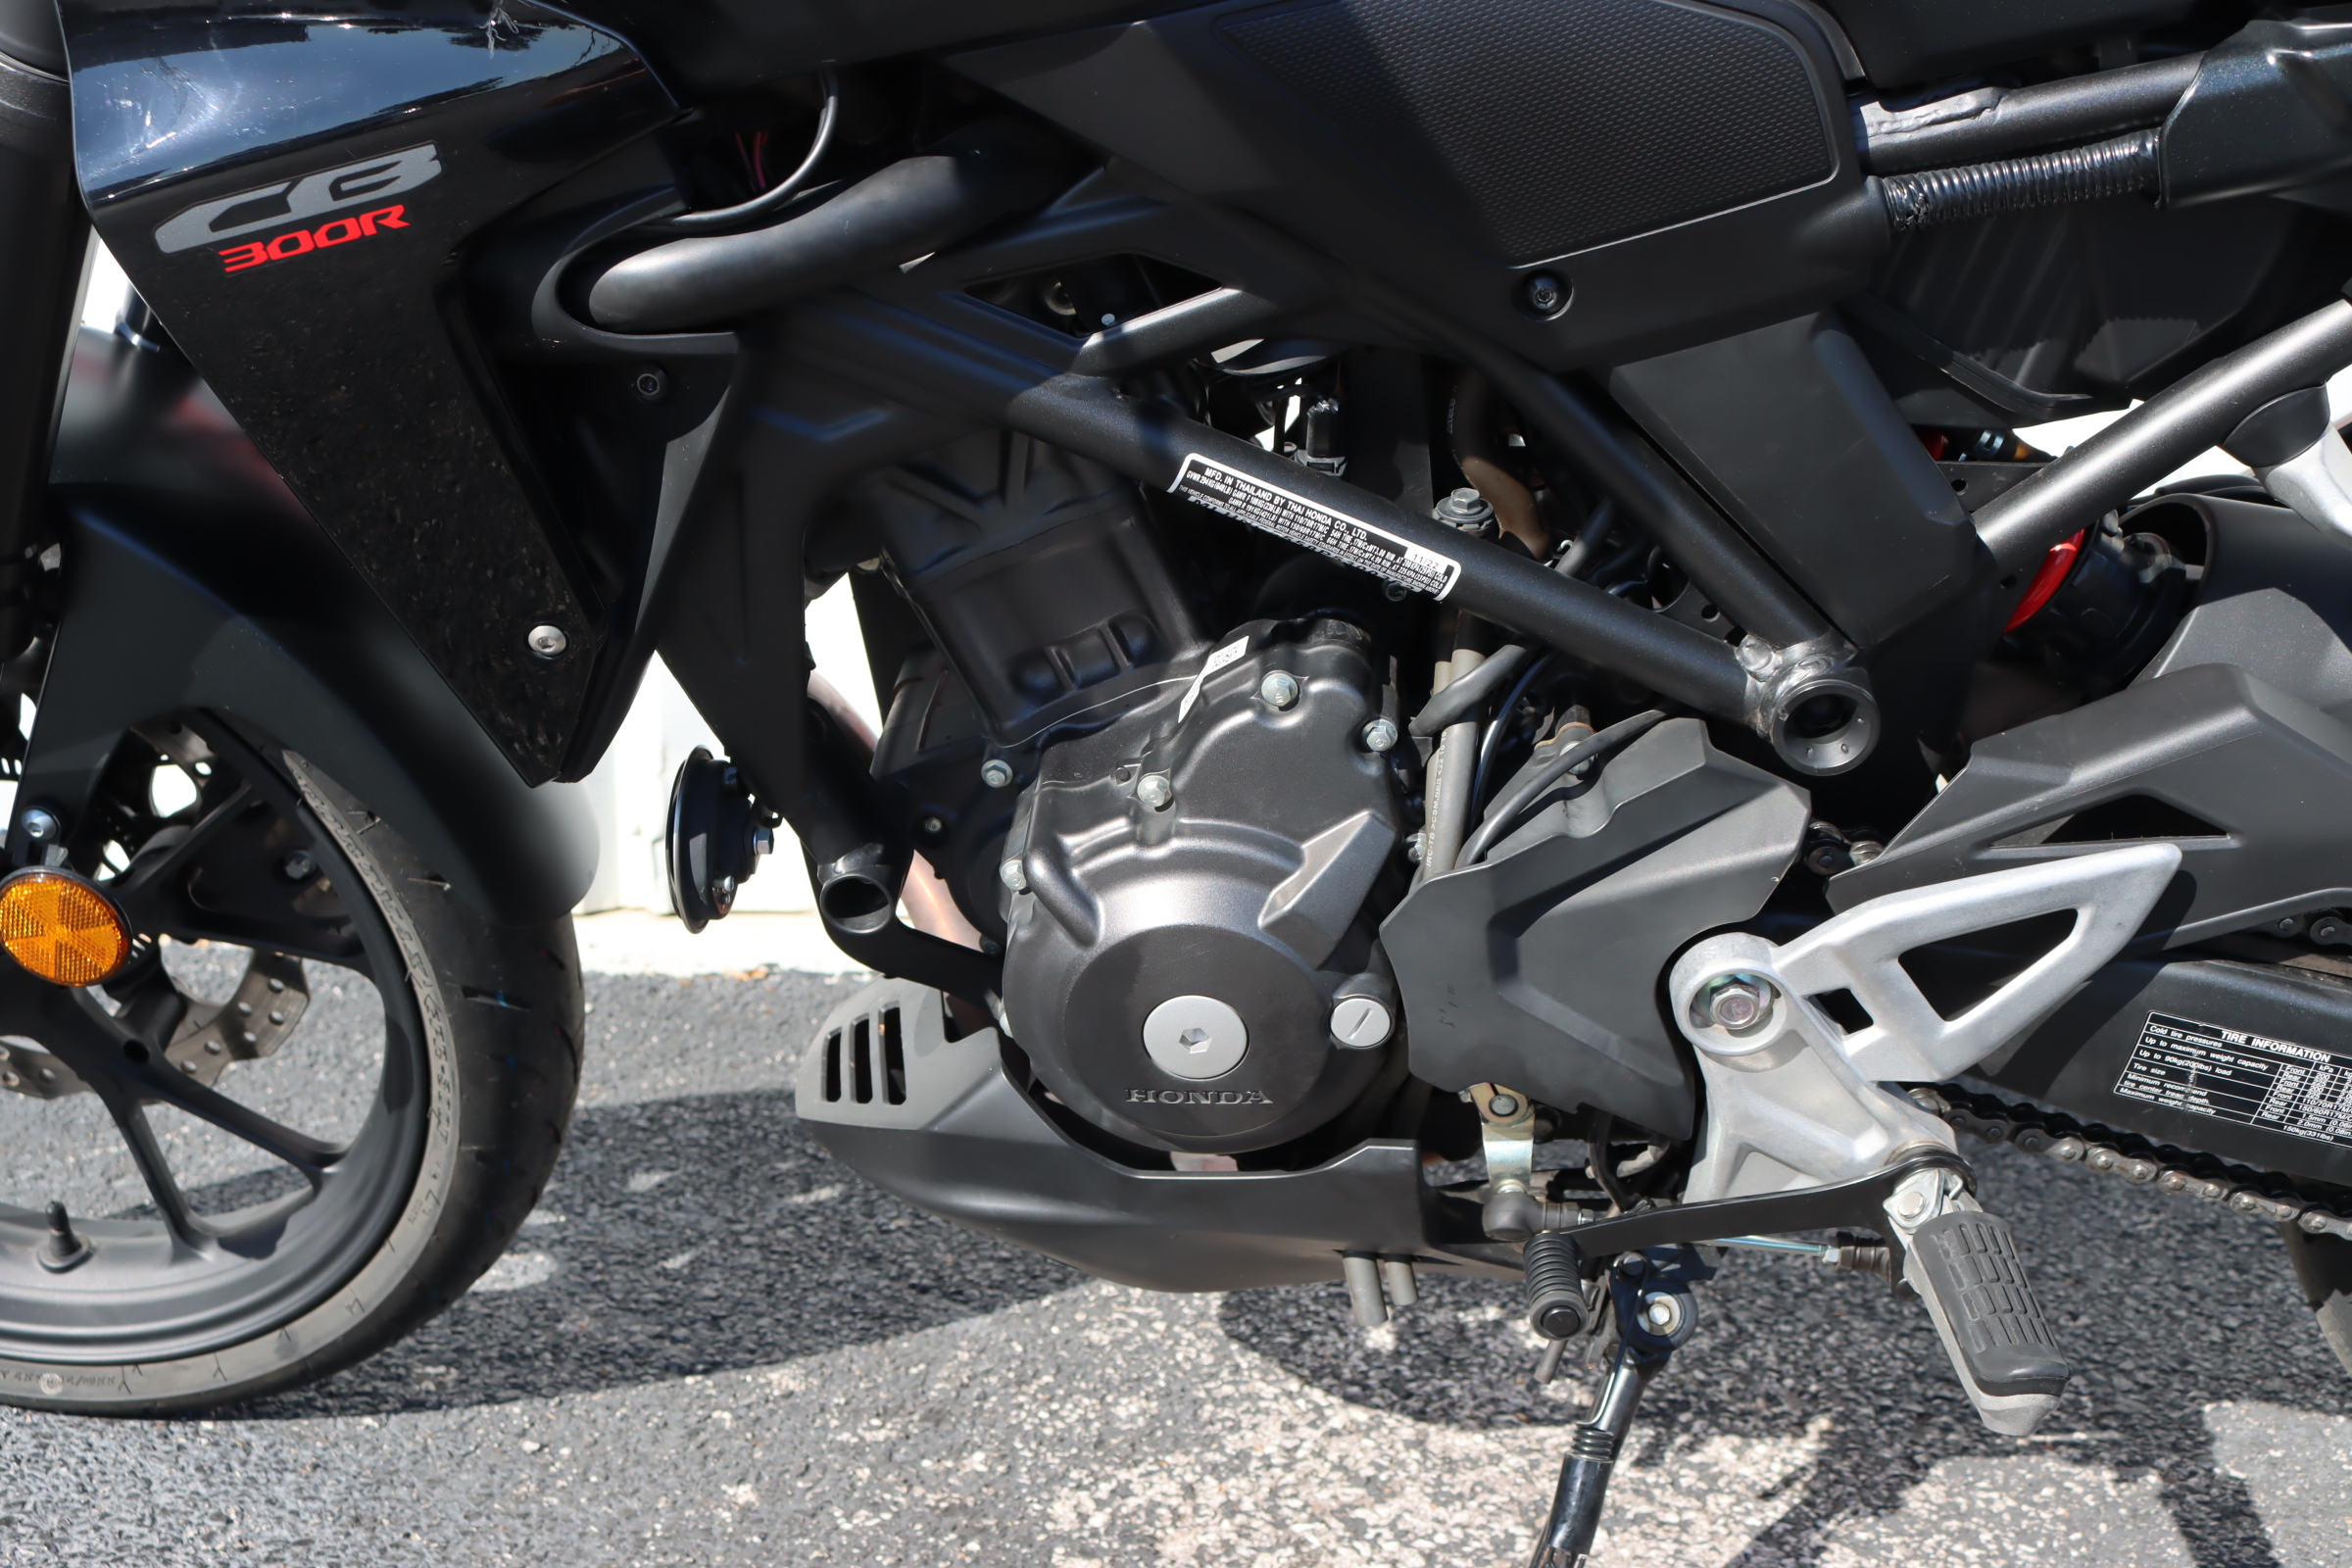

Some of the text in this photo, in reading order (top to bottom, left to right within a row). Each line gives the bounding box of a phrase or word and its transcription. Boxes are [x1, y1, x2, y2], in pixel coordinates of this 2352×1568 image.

[155, 144, 442, 254] CB
[218, 204, 412, 272] 300R
[1203, 466, 1225, 482] MFD.
[1223, 474, 1234, 485] IN
[1234, 478, 1273, 502] THAILAND
[1272, 495, 1286, 507] BY
[1285, 500, 1304, 514] THAI
[1304, 508, 1333, 526] HONDA
[1350, 526, 1369, 541] LTD.
[1187, 487, 1203, 499] VEHICLE
[1202, 494, 1224, 507] CONFORMS
[1288, 528, 1304, 539] VEHICLE
[1302, 534, 1318, 545] SAFETY
[1185, 469, 1201, 482] GVWR
[1280, 508, 1295, 520] WITH
[1434, 571, 1448, 583] COLD
[1277, 515, 1291, 527] WITH
[1429, 579, 1444, 590] COLD
[1411, 553, 1439, 569] 11/22
[2149, 1024, 2167, 1035] Cold
[2184, 1033, 2223, 1048] pressures
[2144, 1036, 2156, 1045] Up
[2170, 1042, 2206, 1055] maximum
[2209, 1051, 2234, 1062] weight
[2236, 1057, 2269, 1071] capacity
[2220, 1030, 2330, 1062] TIRE INFORMATION
[2132, 1062, 2166, 1075] Tire size
[2138, 1049, 2150, 1058] Up
[2215, 1066, 2232, 1076] load
[2285, 1065, 2306, 1075] Front
[2319, 1064, 2333, 1073] kPa
[2127, 1072, 2160, 1086] Minimum
[2279, 1078, 2299, 1088] Front
[2282, 1072, 2302, 1081] Rear
[1126, 1089, 1273, 1104] HONDA
[2119, 1087, 2155, 1100] Maximum
[2157, 1096, 2182, 1107] weight
[2138, 1084, 2162, 1094] center
[2272, 1090, 2292, 1101] Front
[2276, 1085, 2294, 1094] Rear
[2268, 1098, 2287, 1106] Rear
[2261, 1110, 2279, 1120] Rear
[2297, 1119, 2323, 1129] 2.0mm
[2264, 1104, 2284, 1114] Front
[2302, 1113, 2327, 1123] 1.5mm
